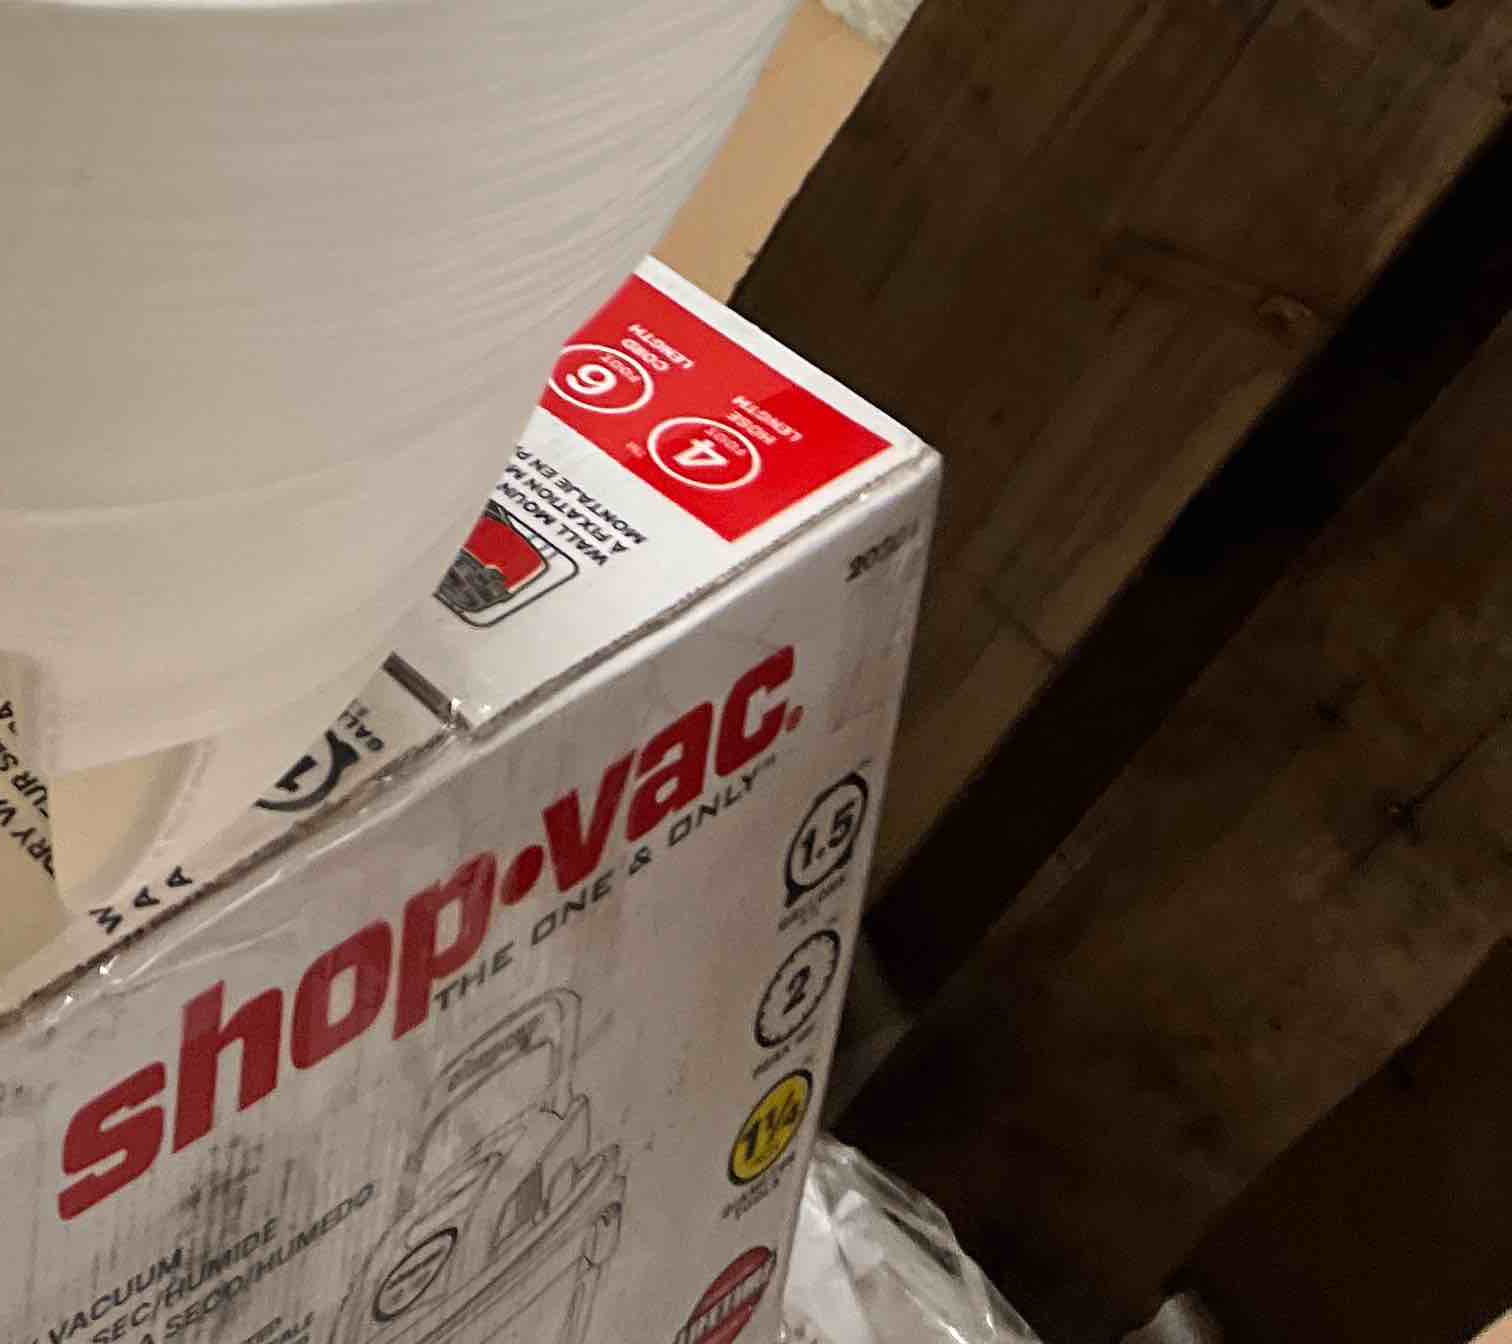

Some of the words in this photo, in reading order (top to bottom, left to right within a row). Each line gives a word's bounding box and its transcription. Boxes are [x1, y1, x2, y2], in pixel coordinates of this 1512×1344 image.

[529, 458, 560, 480] EN
[673, 438, 729, 468] 4
[496, 481, 557, 526] MOUN
[523, 476, 613, 544] FIXATION
[554, 477, 648, 545] MONTAJE
[556, 523, 609, 566] WALL
[802, 799, 856, 871] 1.5
[433, 942, 516, 1013] THE
[531, 874, 614, 946] ONE
[627, 846, 654, 876] &
[783, 964, 812, 1015] 2
[49, 1247, 185, 1344] VACUUM
